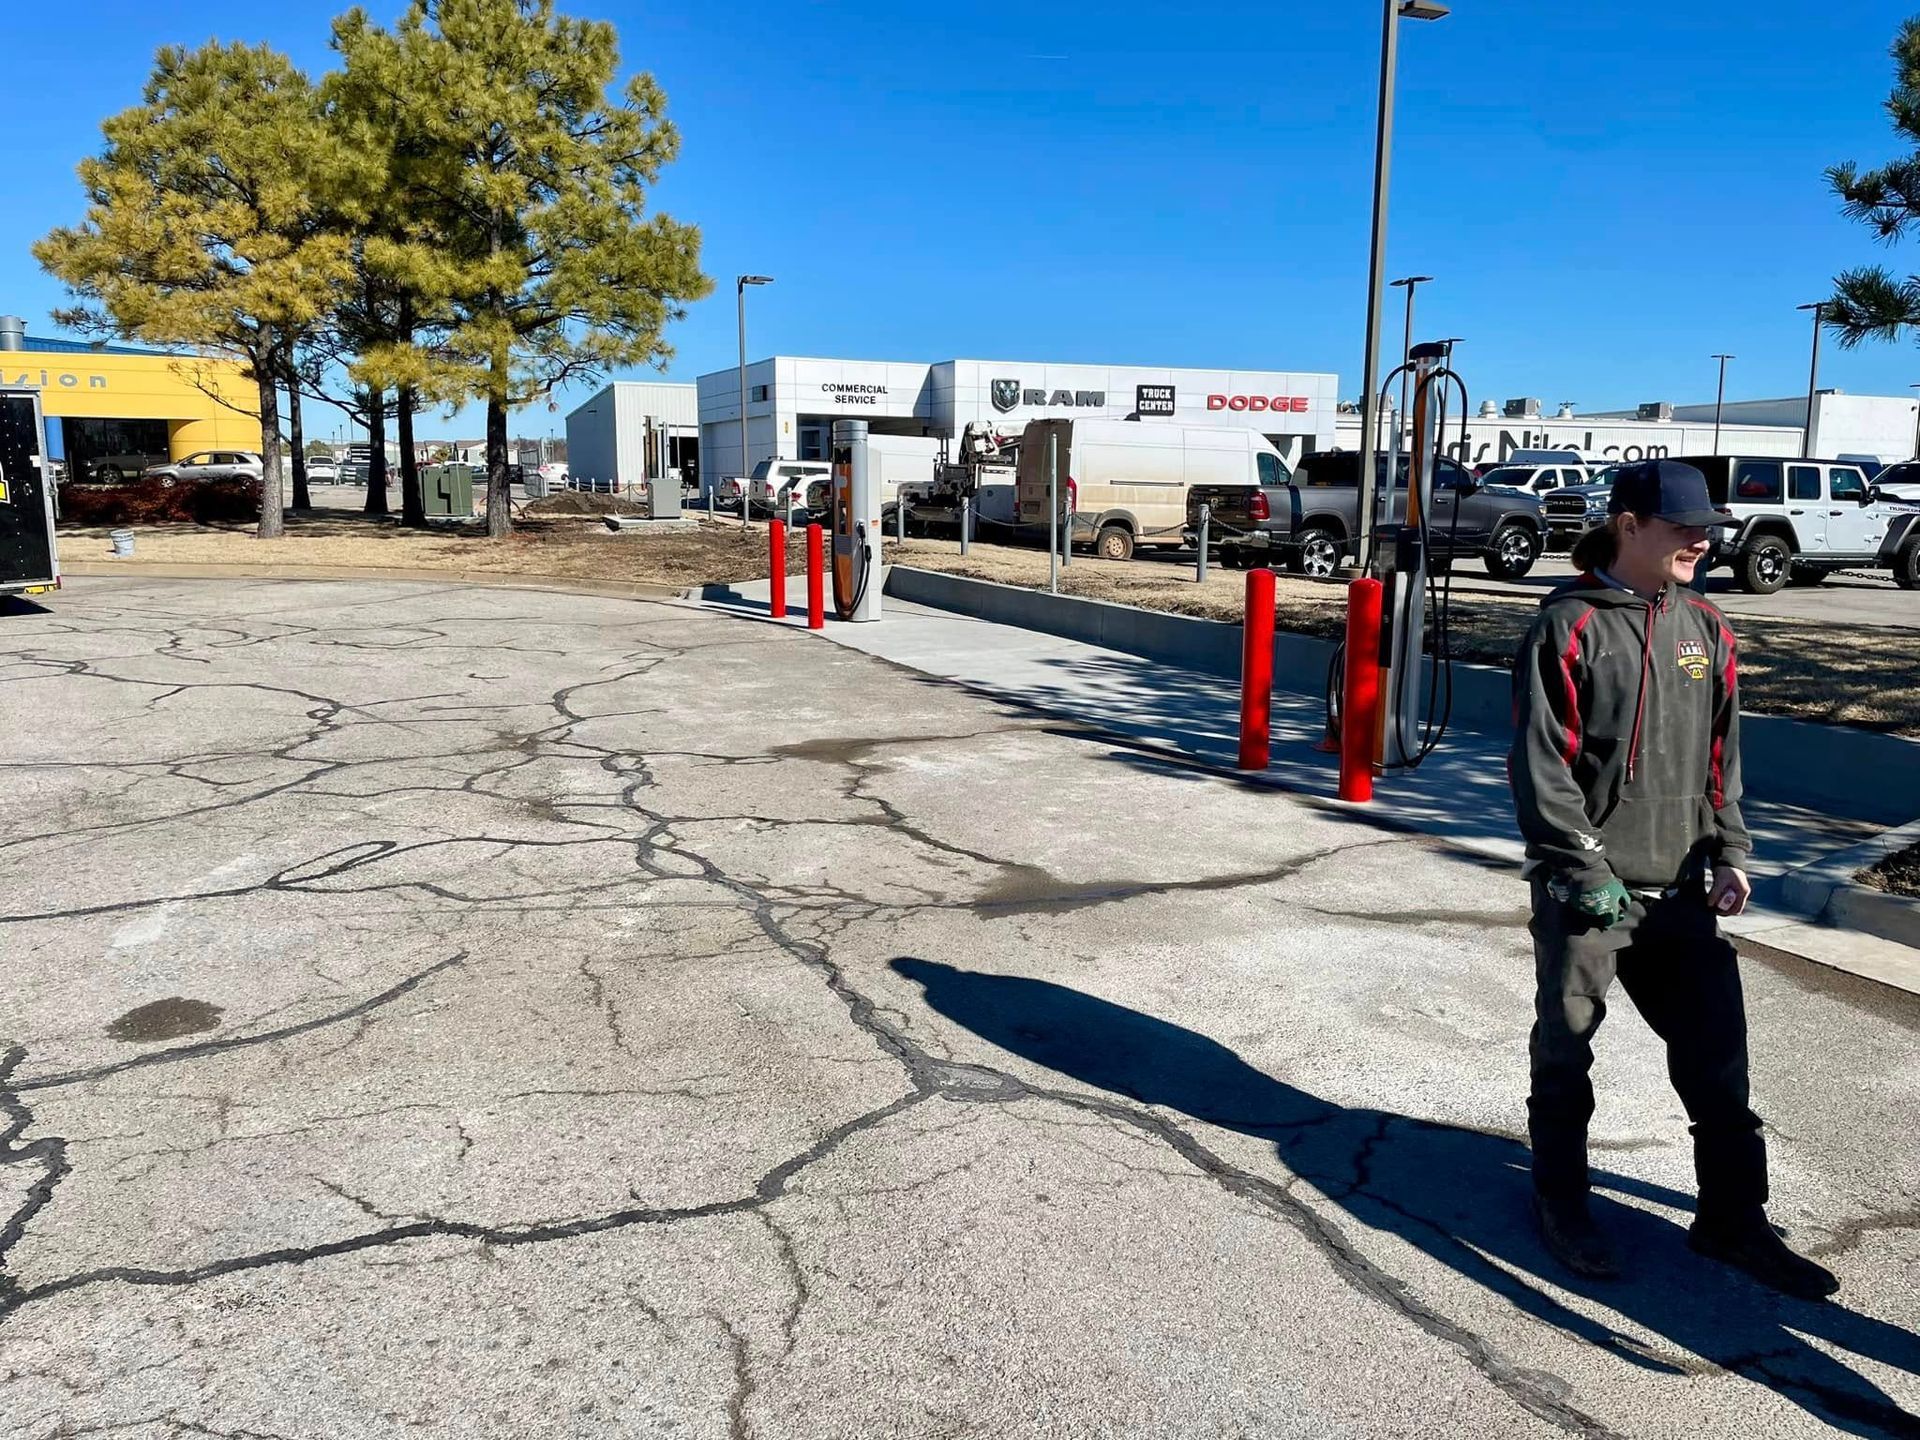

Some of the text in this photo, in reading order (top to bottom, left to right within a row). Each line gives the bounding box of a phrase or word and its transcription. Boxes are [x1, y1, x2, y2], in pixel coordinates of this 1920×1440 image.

[821, 383, 889, 395] COMMERCIAL
[1141, 388, 1171, 399] TRUCK
[834, 394, 877, 405] SERVICE
[1023, 388, 1106, 407] RAM
[1206, 394, 1309, 413] DODGE
[1139, 400, 1173, 412] CENTER
